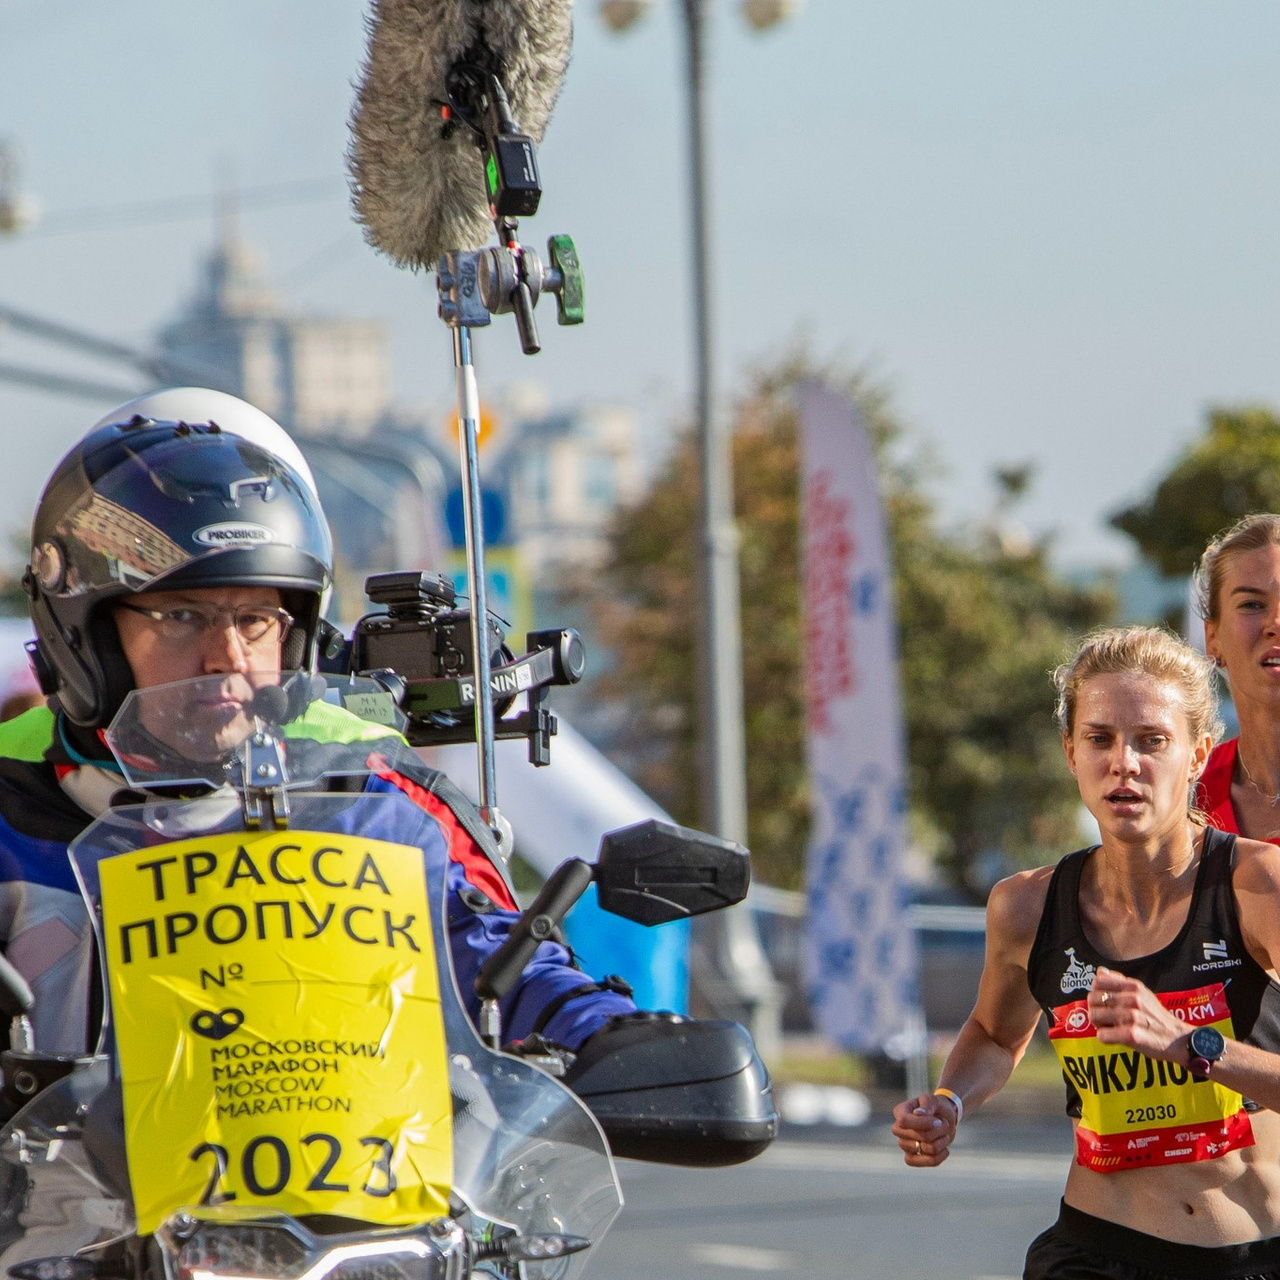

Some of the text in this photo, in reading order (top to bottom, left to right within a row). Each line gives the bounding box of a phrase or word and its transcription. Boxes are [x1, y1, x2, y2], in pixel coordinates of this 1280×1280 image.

[207, 529, 266, 541] PROBIKER
[461, 672, 518, 701] RNIN
[136, 845, 392, 901] ТРАССА
[119, 900, 422, 964] ПРОПУСК
[1192, 958, 1243, 972] NORDSKI
[1061, 977, 1094, 989] bionov
[1187, 1002, 1216, 1021] КМ
[210, 1039, 386, 1062] МОСКОВСКИЙ
[212, 1057, 340, 1081] МАРАФОН
[214, 1077, 325, 1099] MOSCOW
[216, 1096, 351, 1121] MARATHON
[1125, 1104, 1177, 1124] 22030
[188, 1132, 397, 1207] 2023
